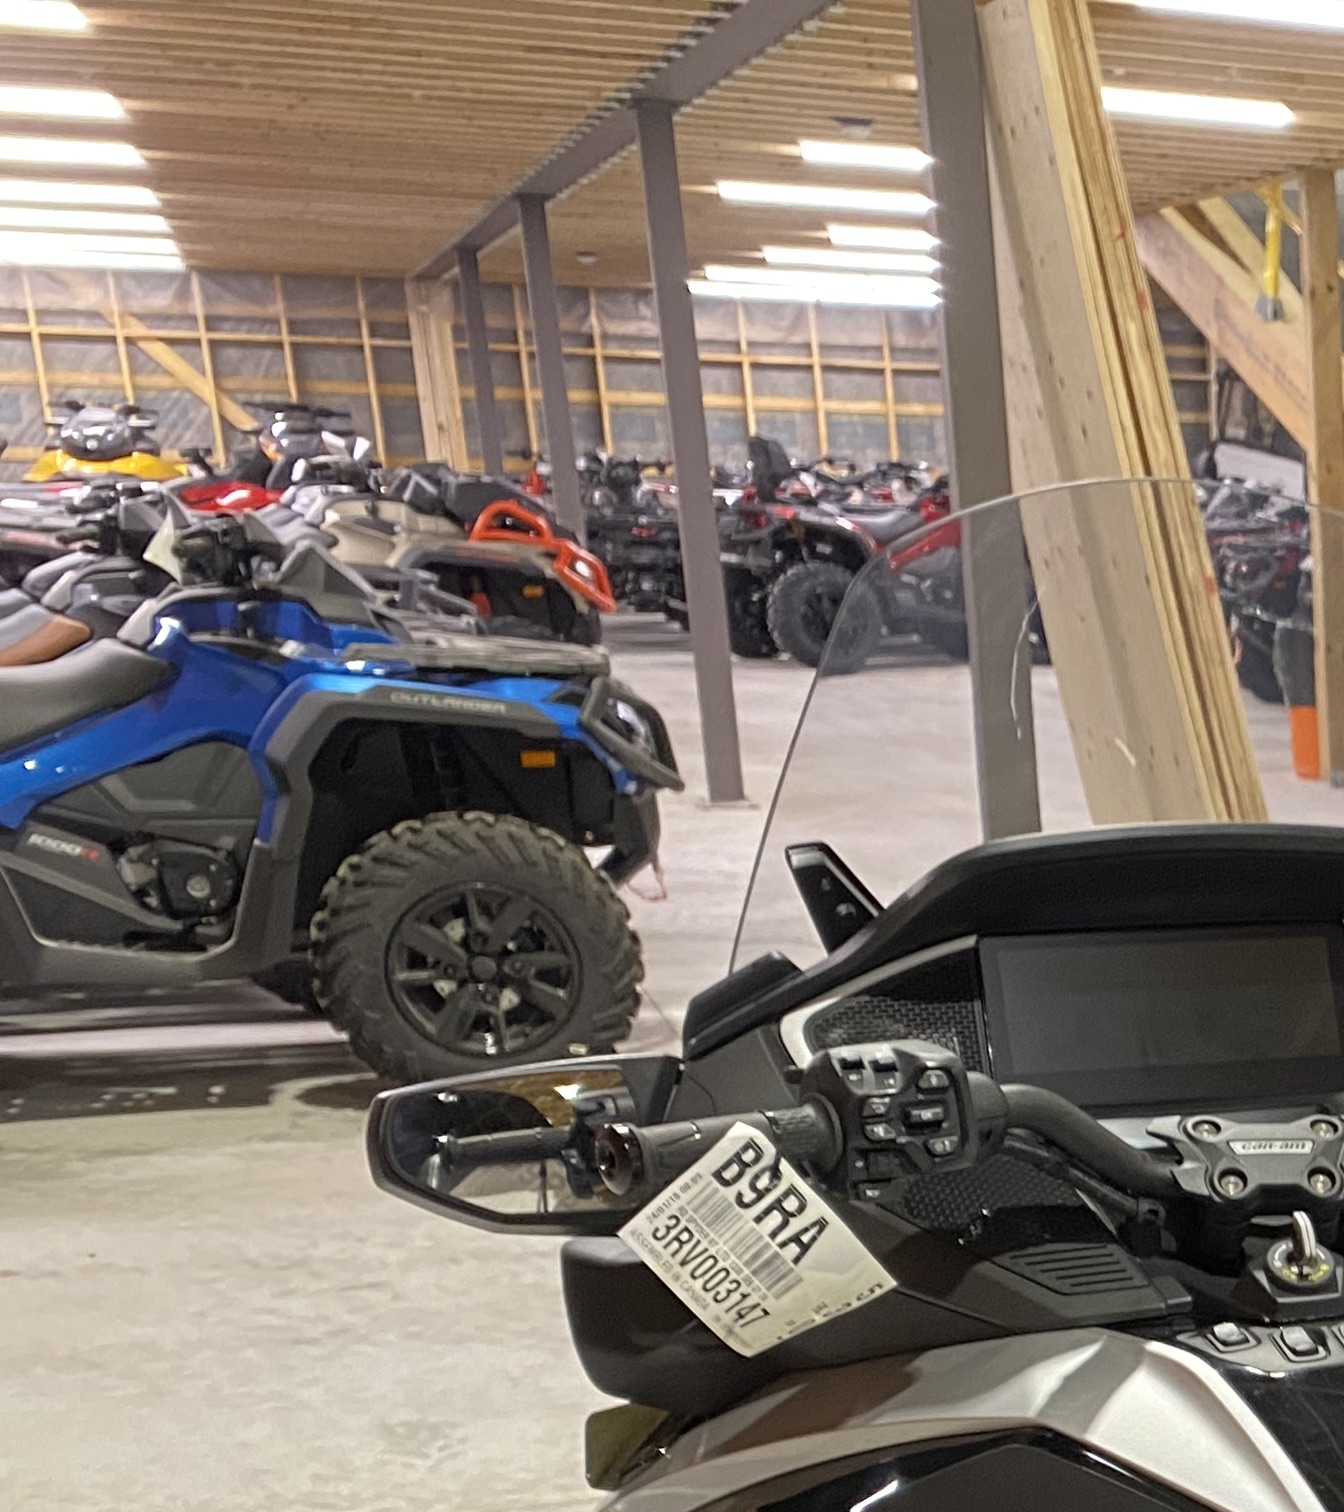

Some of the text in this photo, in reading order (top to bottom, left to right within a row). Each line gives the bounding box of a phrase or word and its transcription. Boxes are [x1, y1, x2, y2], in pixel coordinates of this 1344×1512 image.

[390, 691, 506, 714] OUTLANDER
[711, 1137, 829, 1266] B9RA
[652, 1215, 770, 1328] 3RV003147
